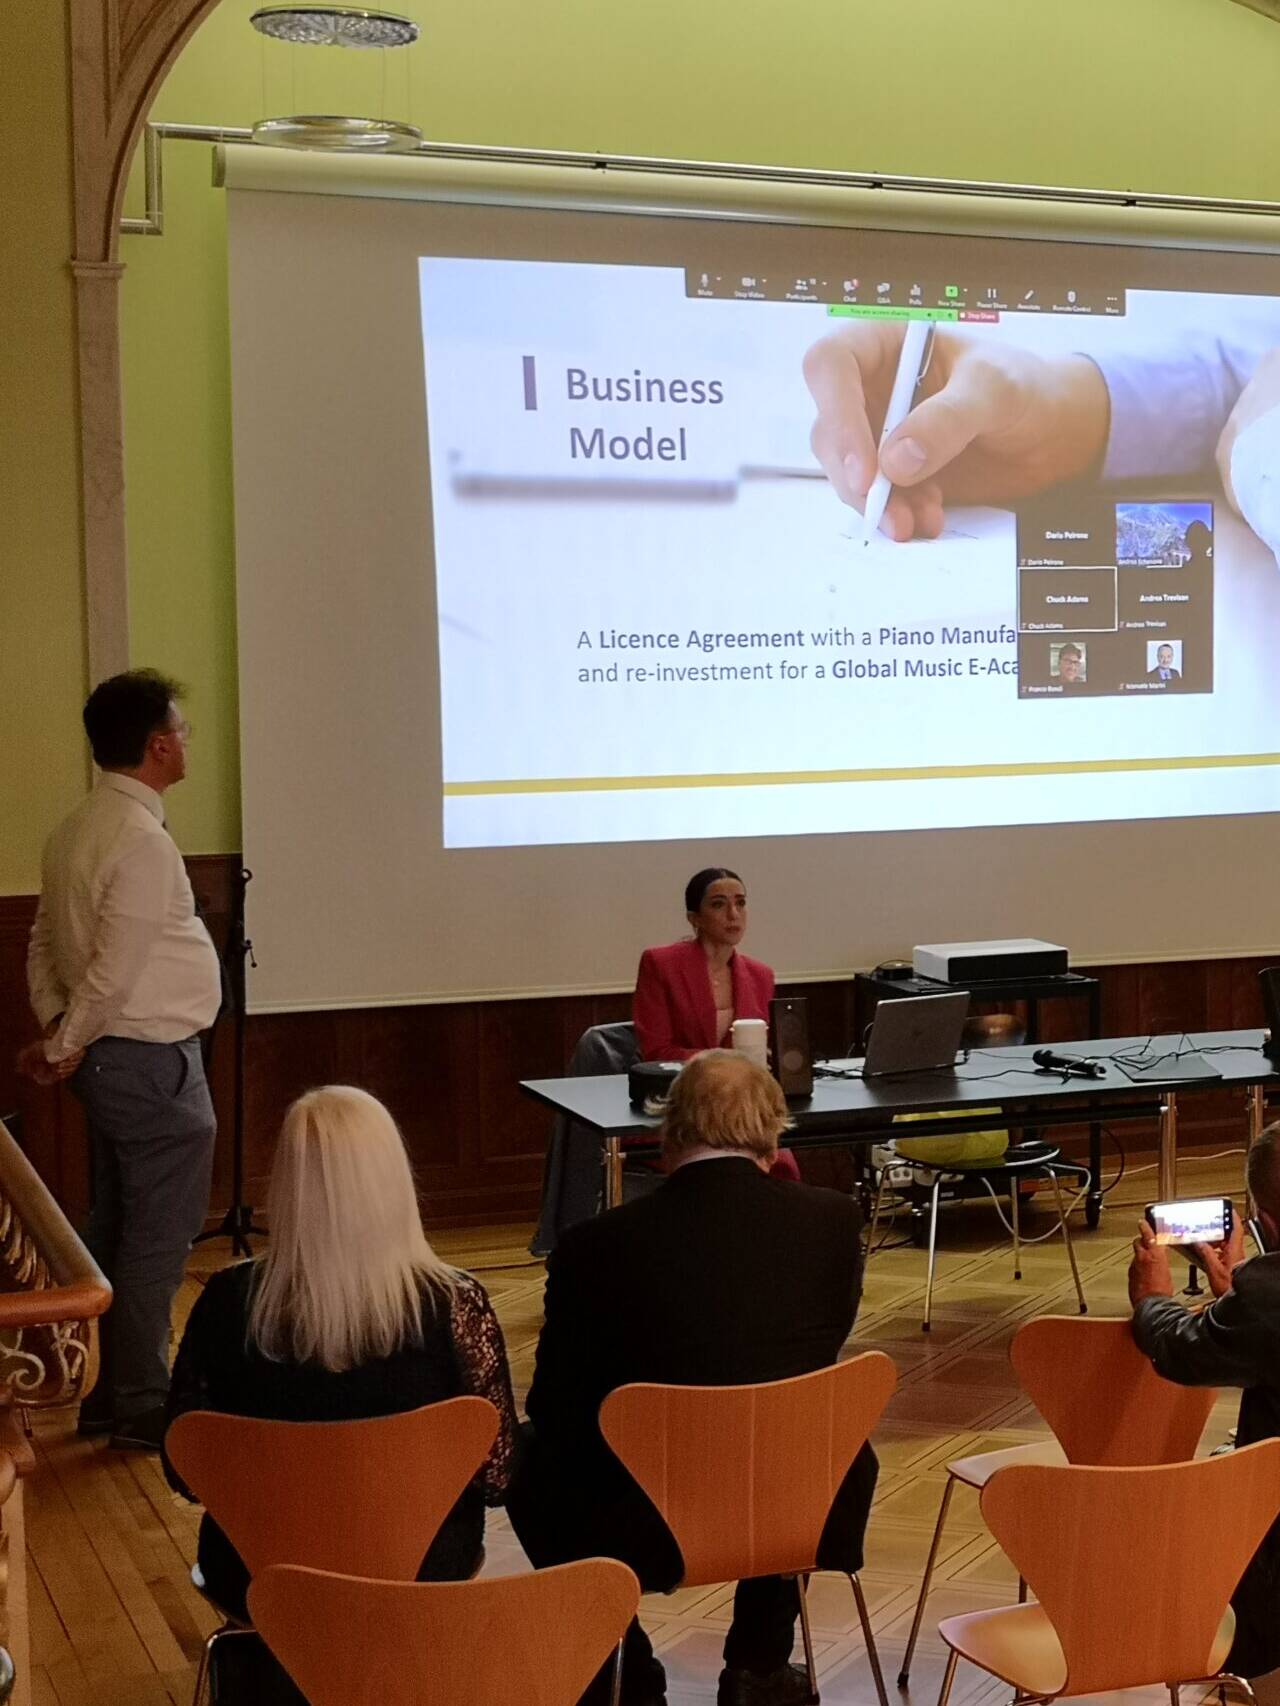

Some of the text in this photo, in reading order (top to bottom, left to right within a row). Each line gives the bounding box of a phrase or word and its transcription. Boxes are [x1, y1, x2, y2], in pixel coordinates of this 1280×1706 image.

[567, 368, 724, 404] Business
[570, 426, 686, 460] Model
[1046, 531, 1063, 540] Dario
[1140, 594, 1162, 602] Andrea
[577, 624, 1016, 652] A Licence Agreement with a Piano Manufa
[578, 662, 618, 682] and
[626, 660, 773, 682] re-investment
[780, 660, 808, 679] for
[815, 664, 826, 678] a
[832, 659, 898, 678] Global
[904, 658, 963, 677] Music
